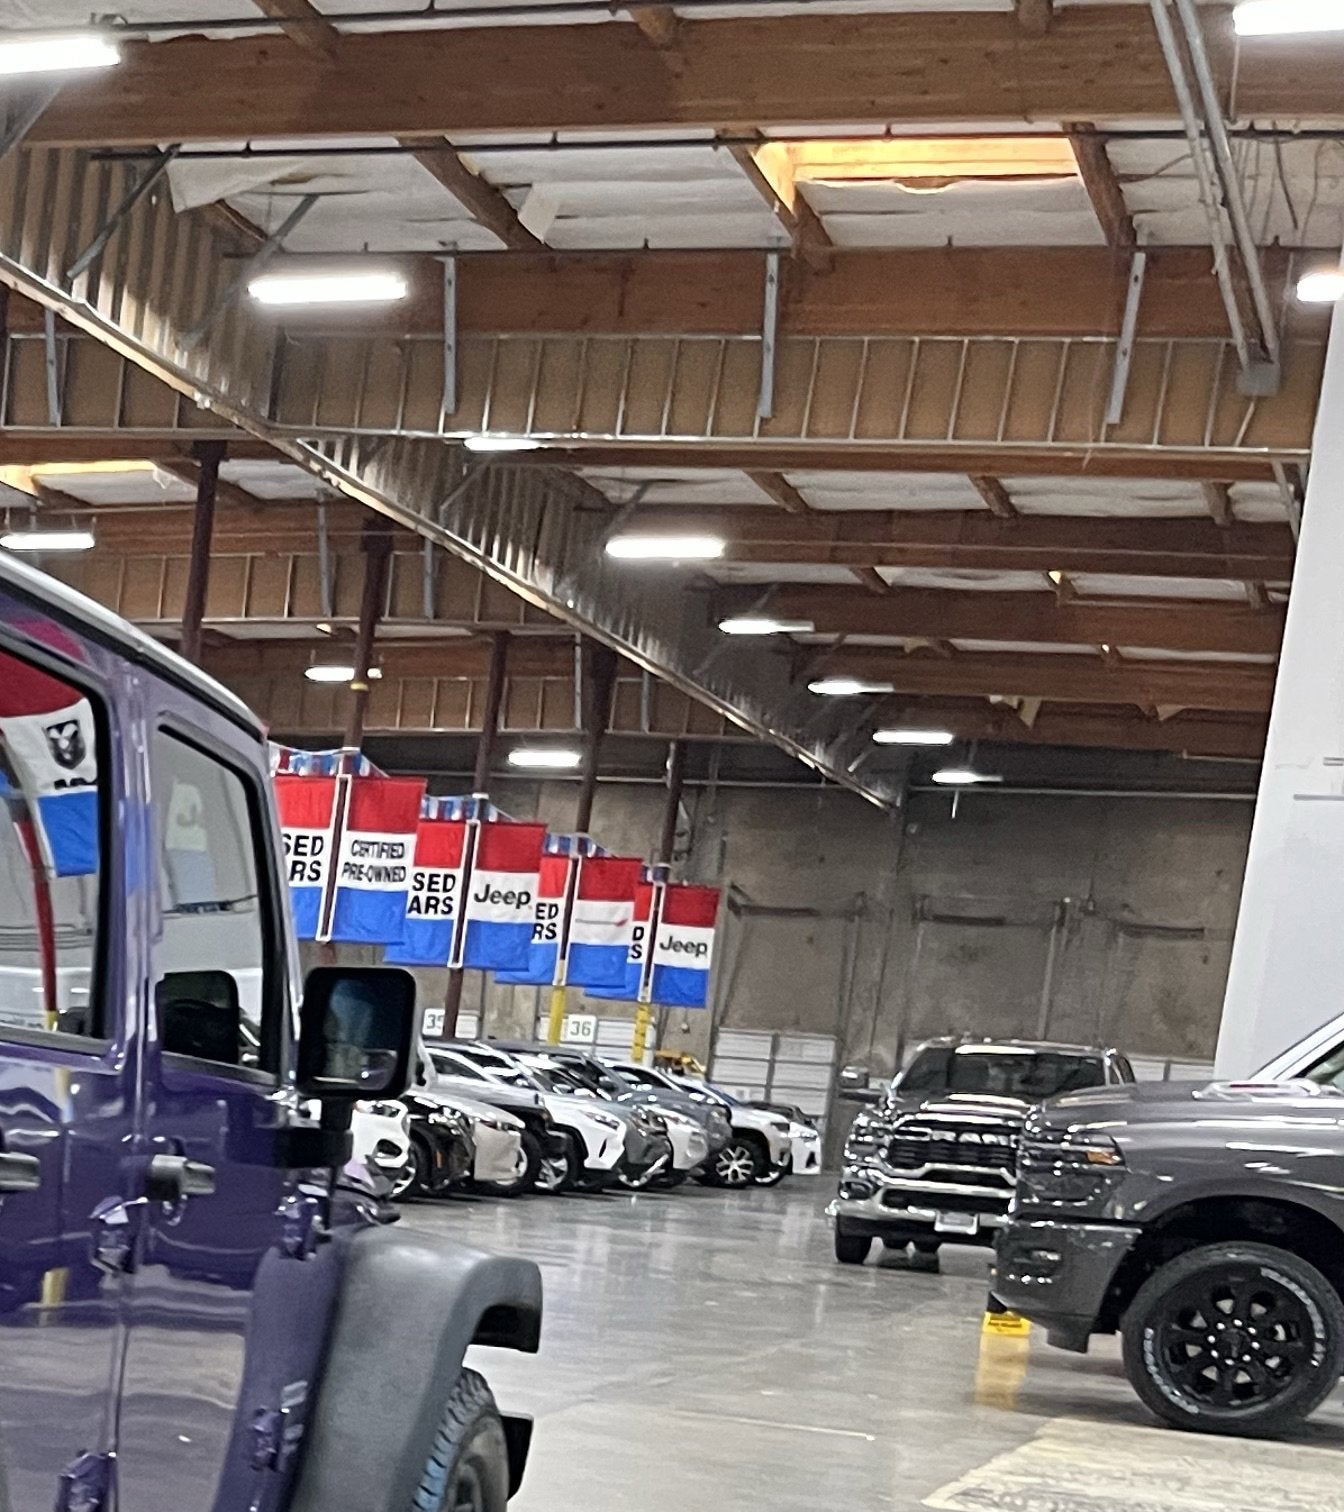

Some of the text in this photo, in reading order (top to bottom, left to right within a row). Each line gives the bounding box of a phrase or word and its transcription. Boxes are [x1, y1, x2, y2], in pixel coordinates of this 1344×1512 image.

[351, 839, 405, 859] CERTIFIED
[341, 861, 407, 882] PRE-OWNED
[412, 872, 456, 893] SED
[407, 895, 454, 915] ARS
[473, 883, 531, 910] Jeep
[659, 935, 709, 958] Jeep
[570, 1020, 592, 1037] 36
